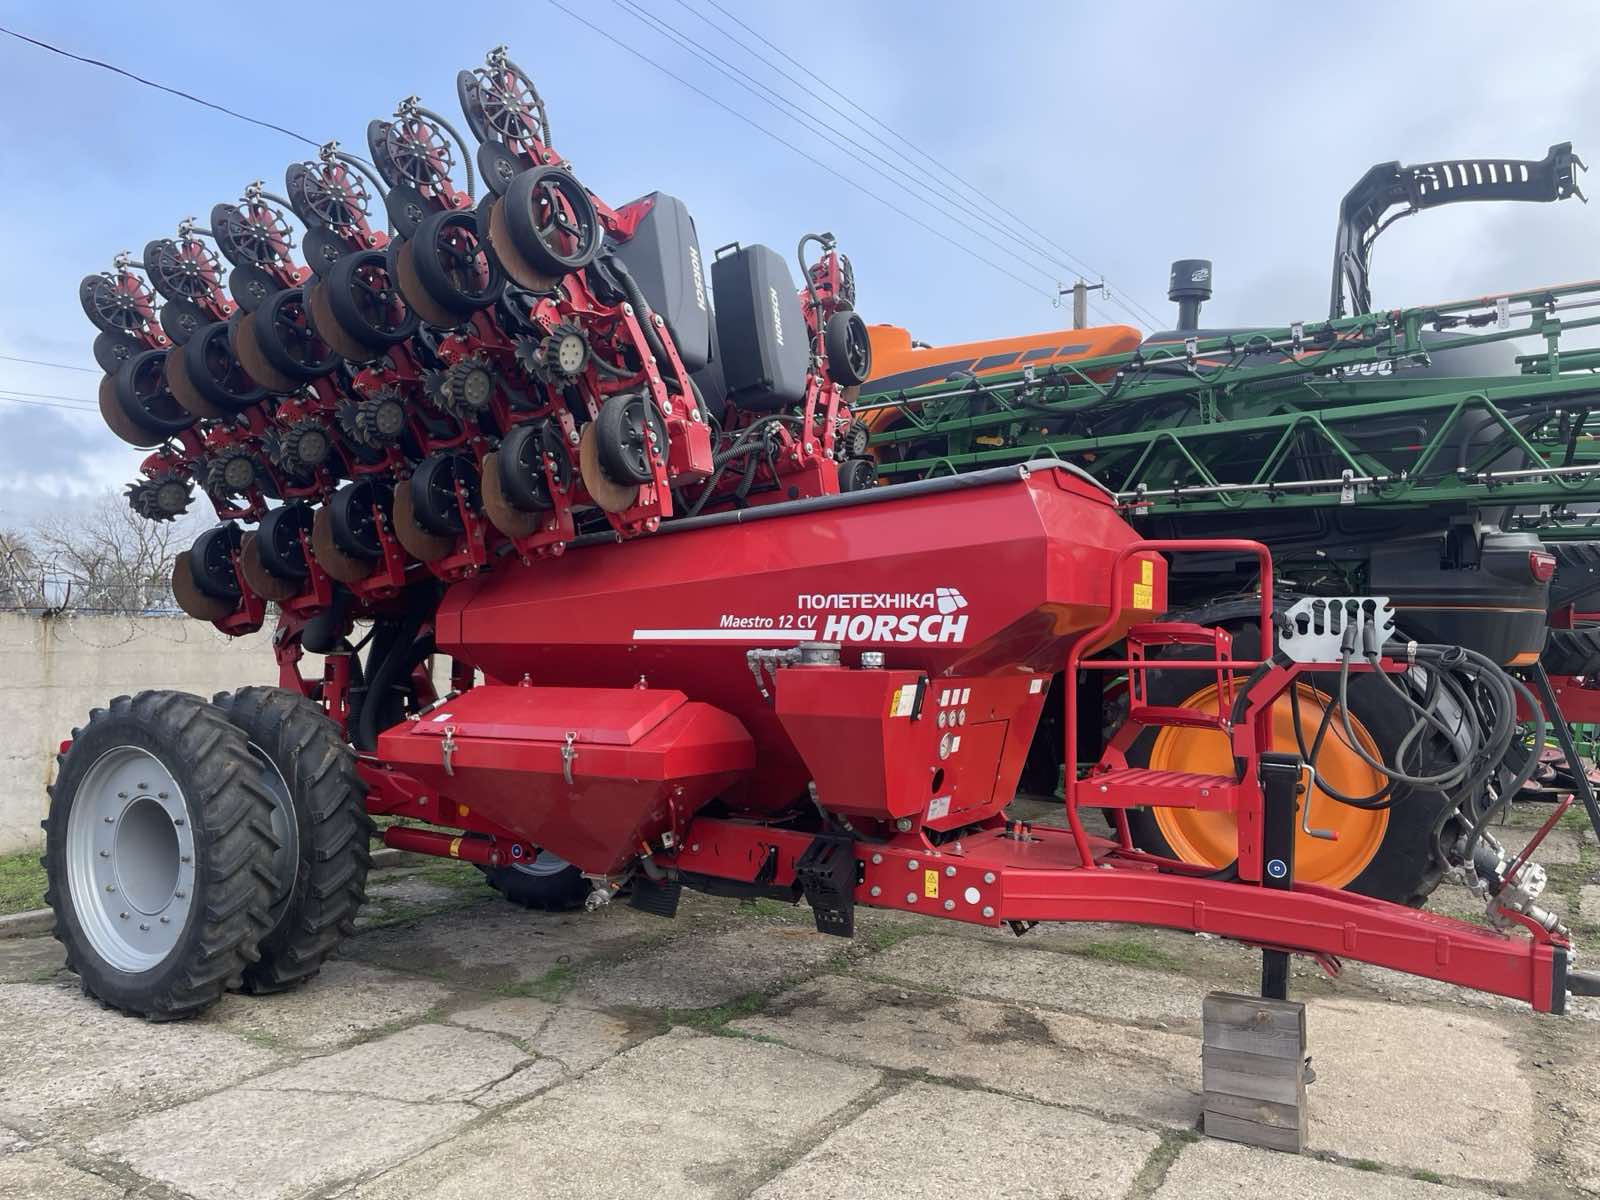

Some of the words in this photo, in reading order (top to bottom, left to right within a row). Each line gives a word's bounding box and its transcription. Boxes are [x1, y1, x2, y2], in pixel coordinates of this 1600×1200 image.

[690, 246, 706, 311] HORSCH
[770, 287, 784, 346] HORSCH
[798, 593, 935, 609] ПОЛЕТЕХНІКА
[720, 615, 773, 629] Maestro
[778, 615, 793, 629] 12
[797, 615, 818, 629] CV
[823, 615, 968, 642] HORSCH
